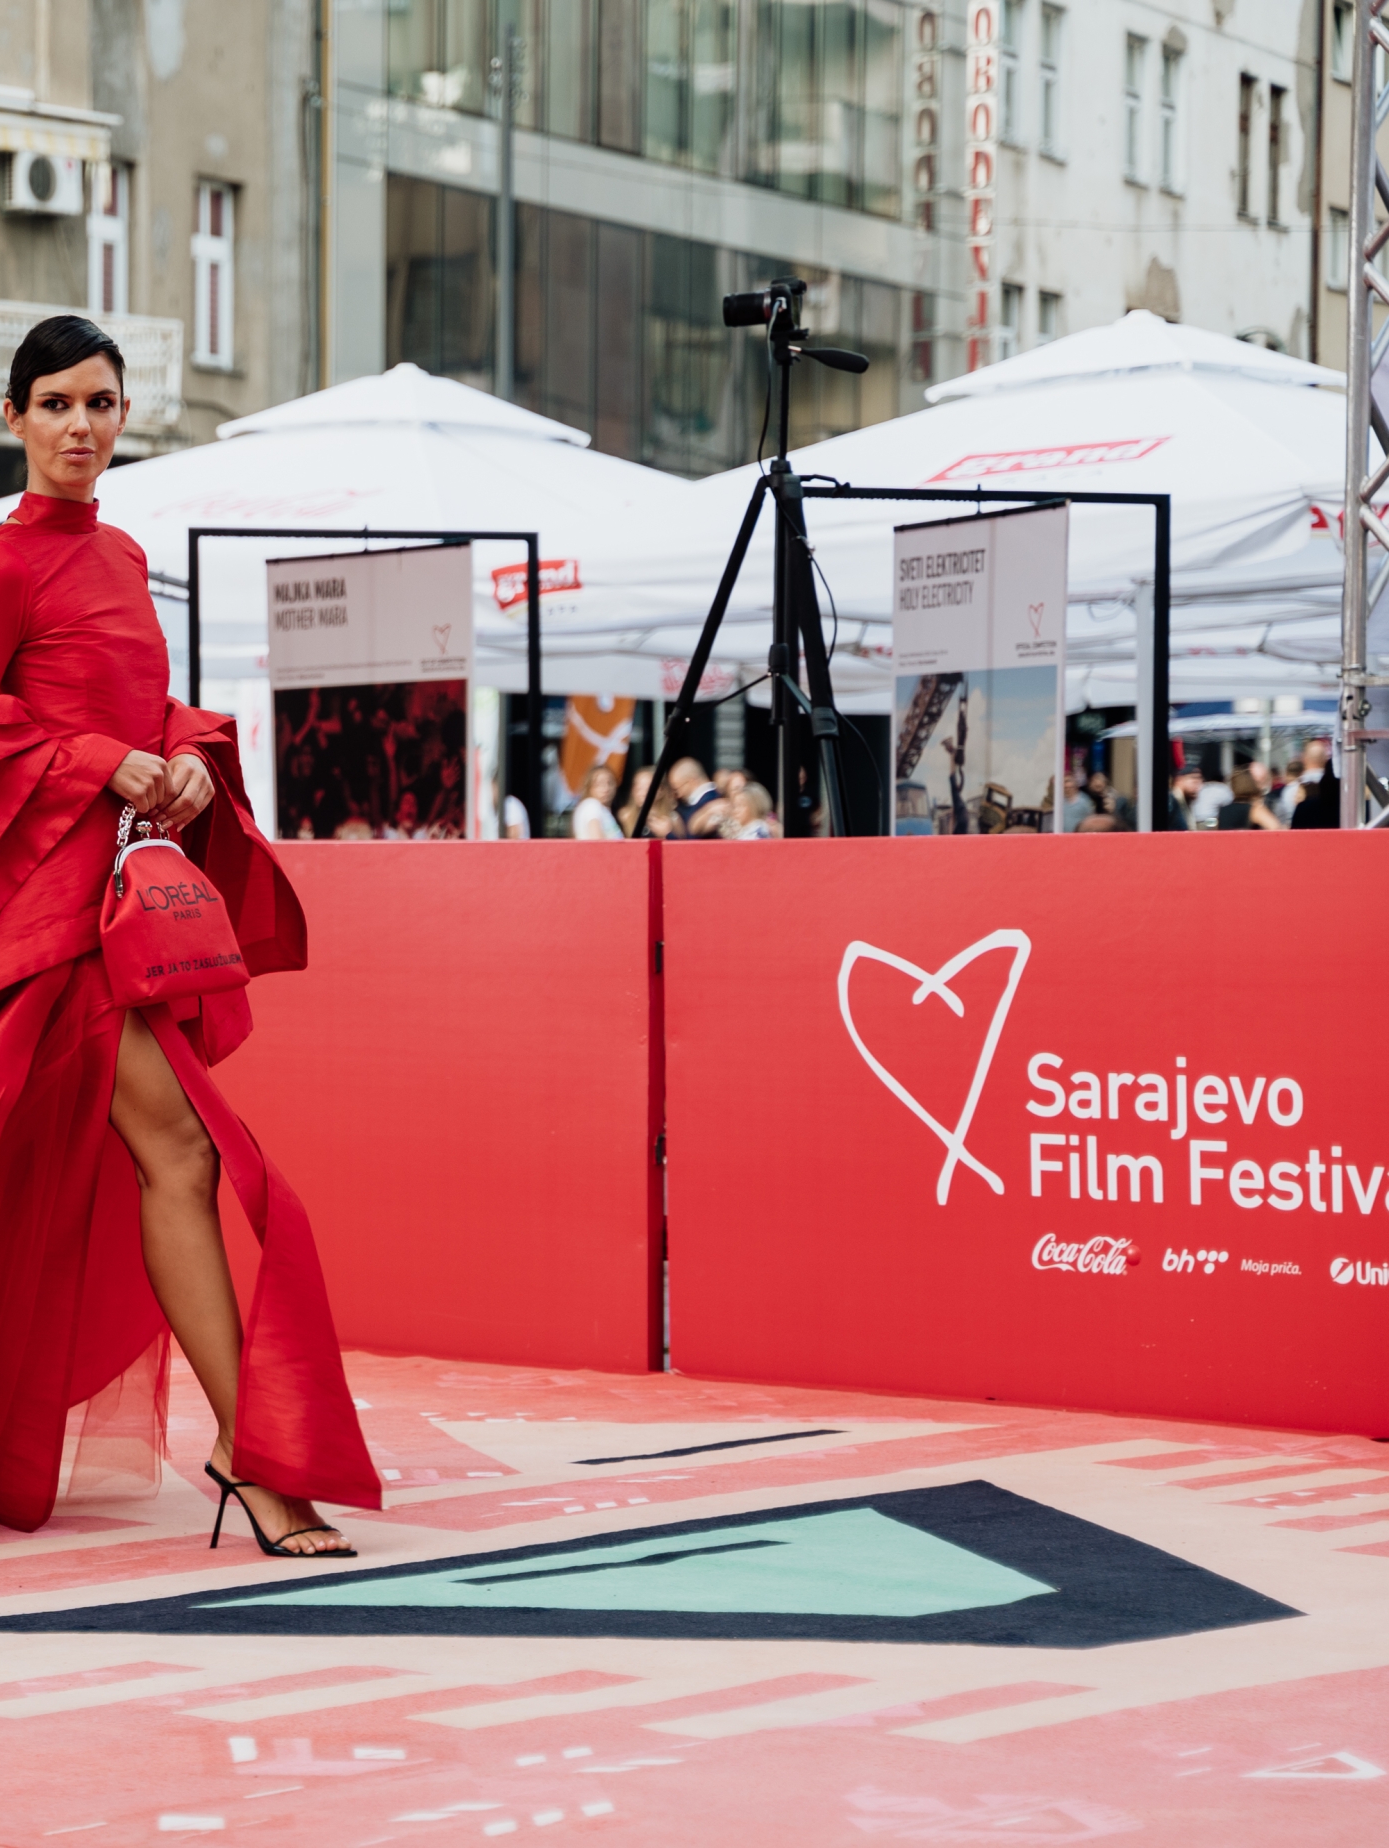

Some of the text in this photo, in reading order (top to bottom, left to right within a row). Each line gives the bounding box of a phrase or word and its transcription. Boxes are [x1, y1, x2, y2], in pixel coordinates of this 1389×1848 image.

[273, 576, 347, 604] MAJKA MARA
[274, 604, 348, 631] MOTHER MARA
[173, 908, 202, 921] PARIS
[145, 964, 165, 979] JER
[167, 963, 179, 975] JA
[179, 961, 191, 973] TO
[1026, 1052, 1304, 1140] Sarajevo
[1030, 1133, 1389, 1214] Film Festiv
[1032, 1233, 1389, 1286] Coca-Cola bh Moja priča. Uni
